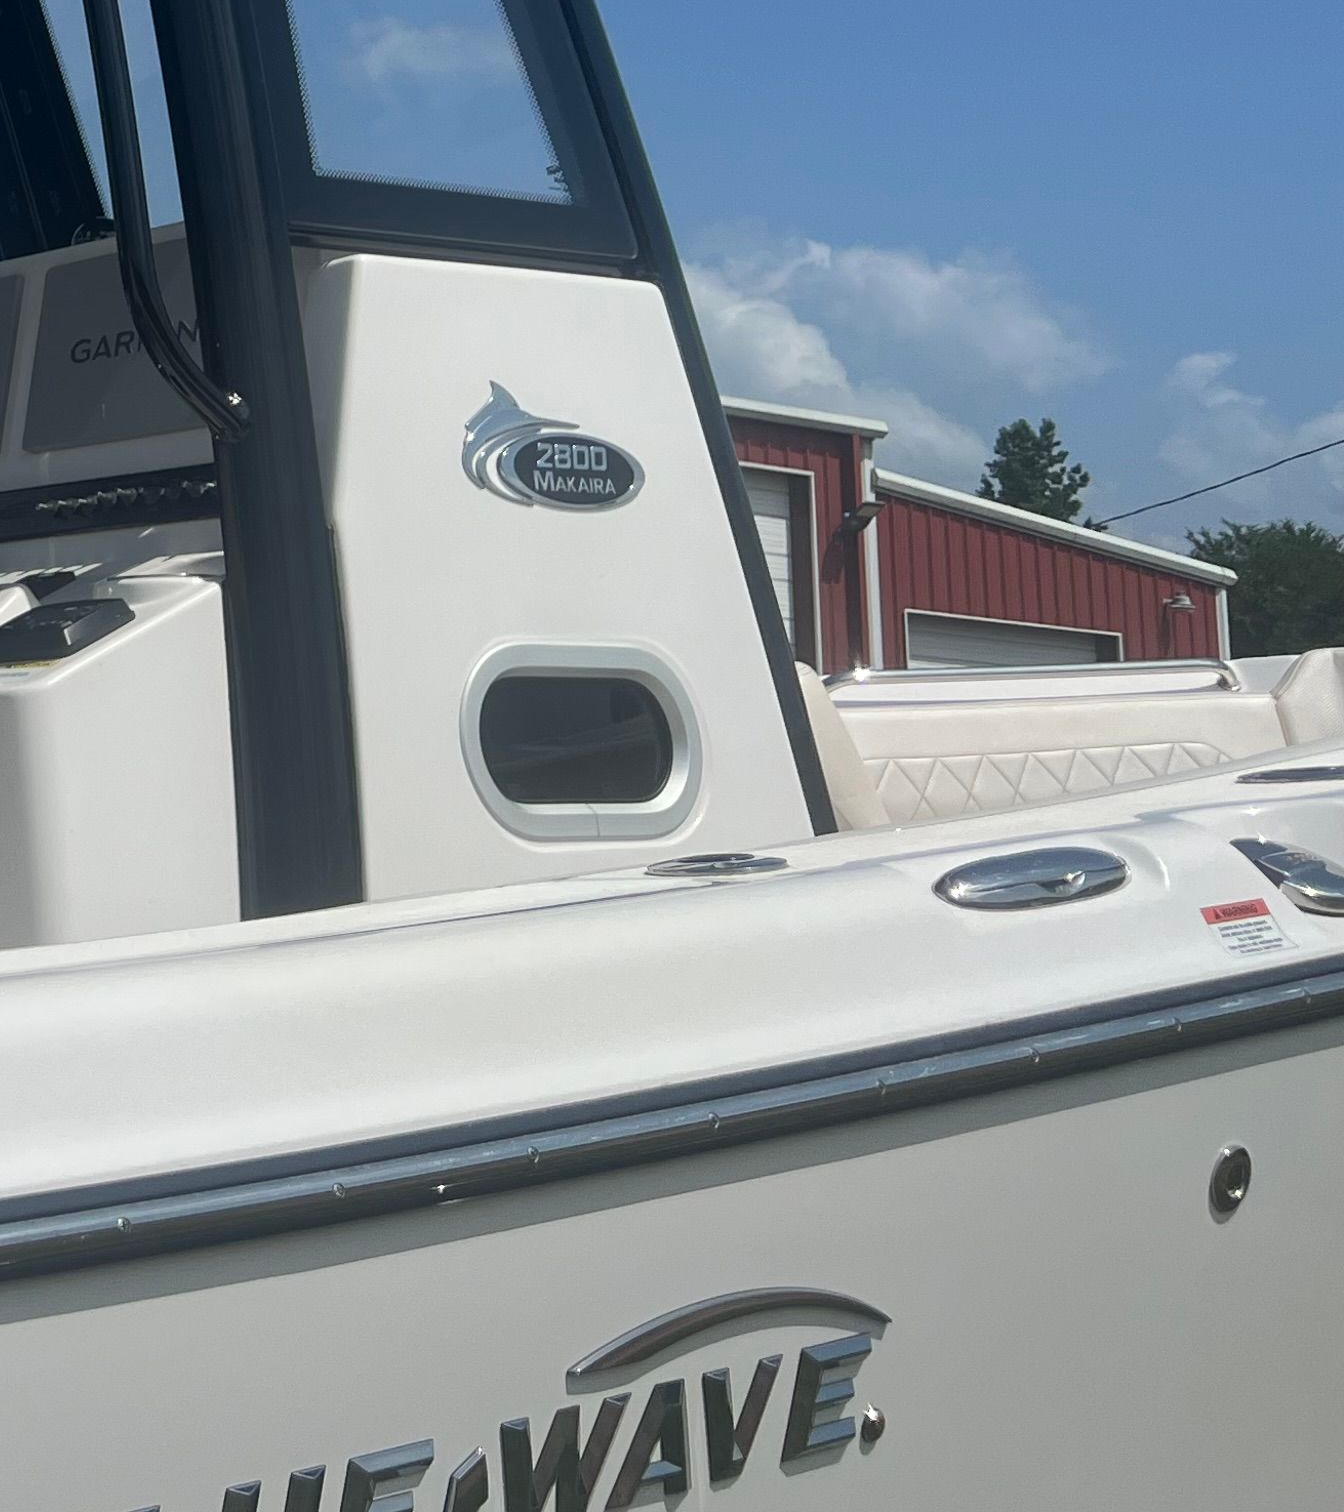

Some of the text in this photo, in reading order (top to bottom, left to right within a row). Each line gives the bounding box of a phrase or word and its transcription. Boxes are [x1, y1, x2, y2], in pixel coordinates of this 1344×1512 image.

[70, 318, 199, 364] GARN
[536, 442, 608, 471] 2800
[533, 470, 617, 495] MAKAIRA
